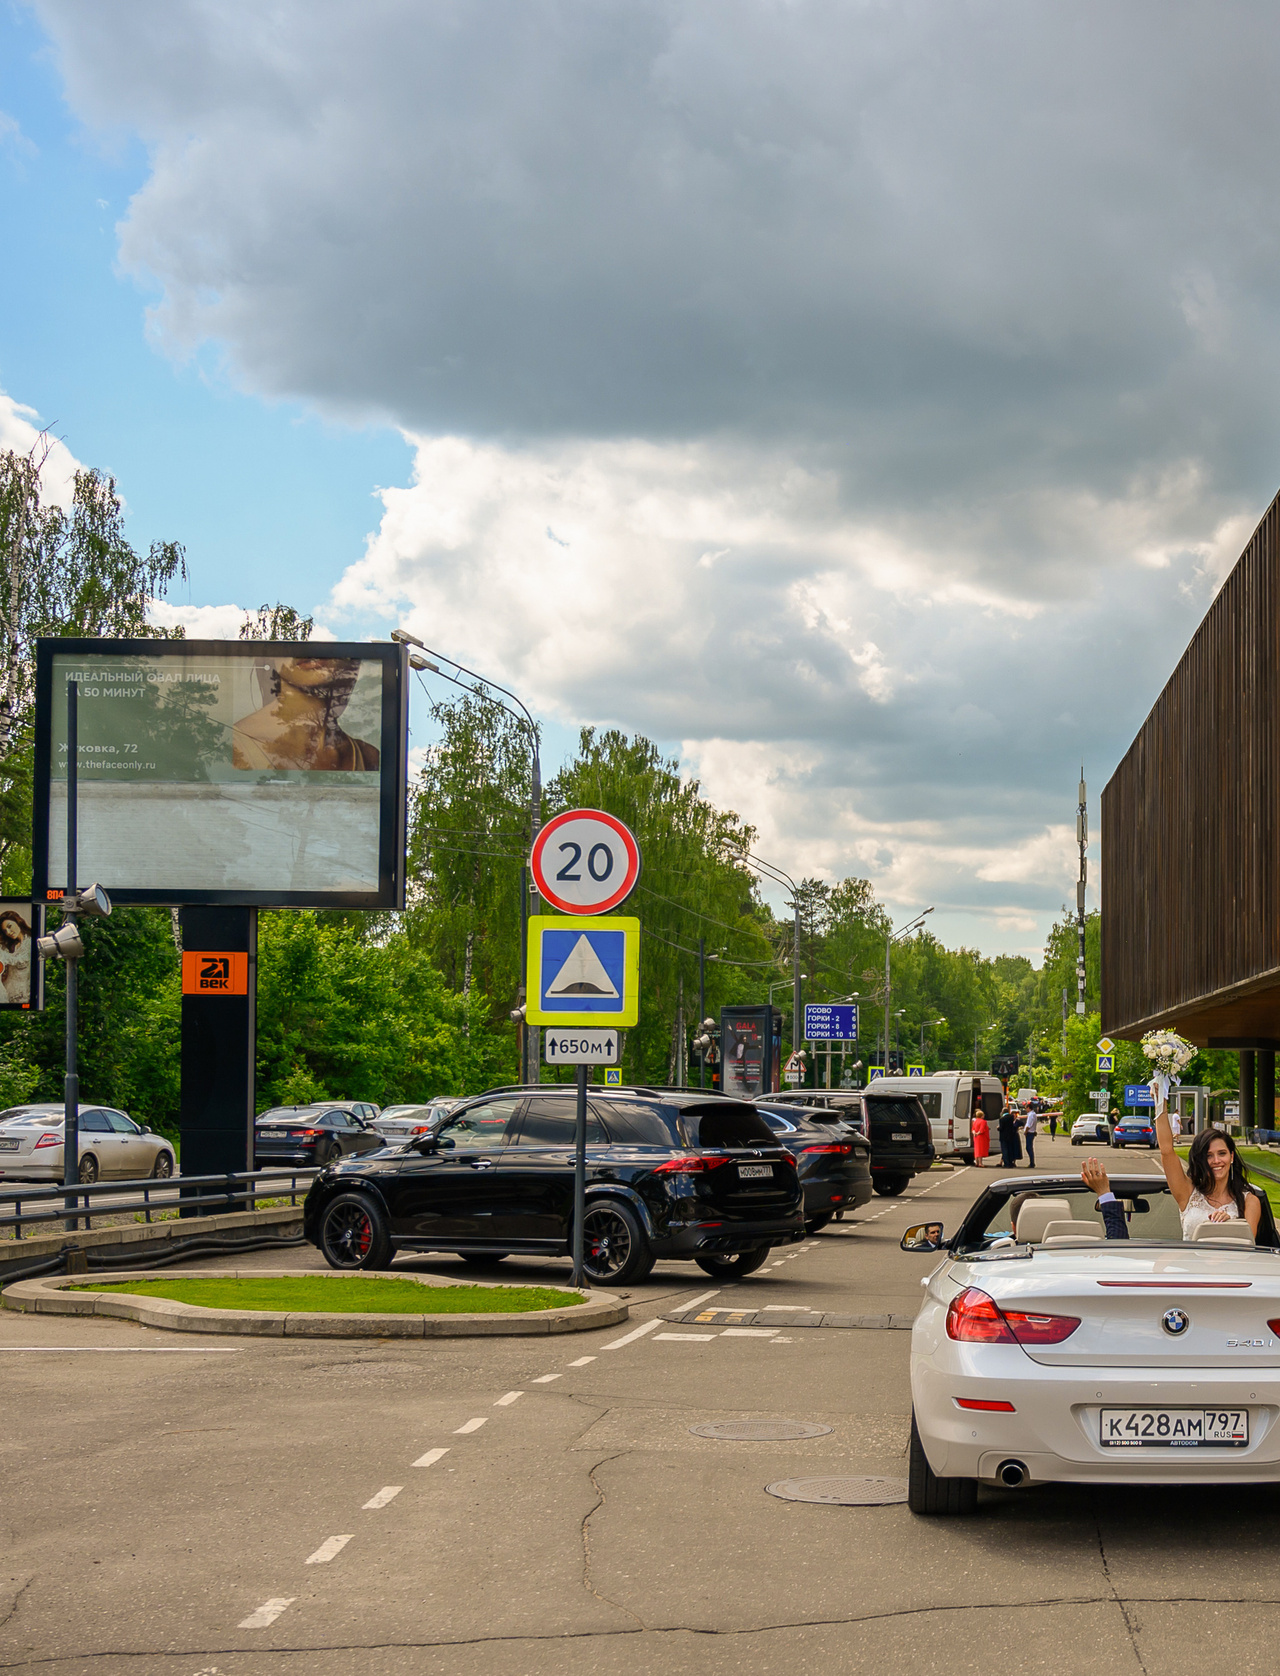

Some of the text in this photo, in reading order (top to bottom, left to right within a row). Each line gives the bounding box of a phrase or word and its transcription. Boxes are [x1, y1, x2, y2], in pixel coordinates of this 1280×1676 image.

[65, 671, 221, 684] ИДЕАЛЬНЫЙ ОВАЛ ЛИЦА
[84, 687, 100, 697] 50
[103, 687, 146, 698] МИНУТ
[58, 743, 138, 754] Жковка, 72
[58, 760, 156, 771] ww.thefaceonly.ru
[556, 842, 614, 882] 20
[201, 958, 229, 978] 21
[736, 1022, 756, 1030] GALA
[1206, 1413, 1241, 1430] 797
